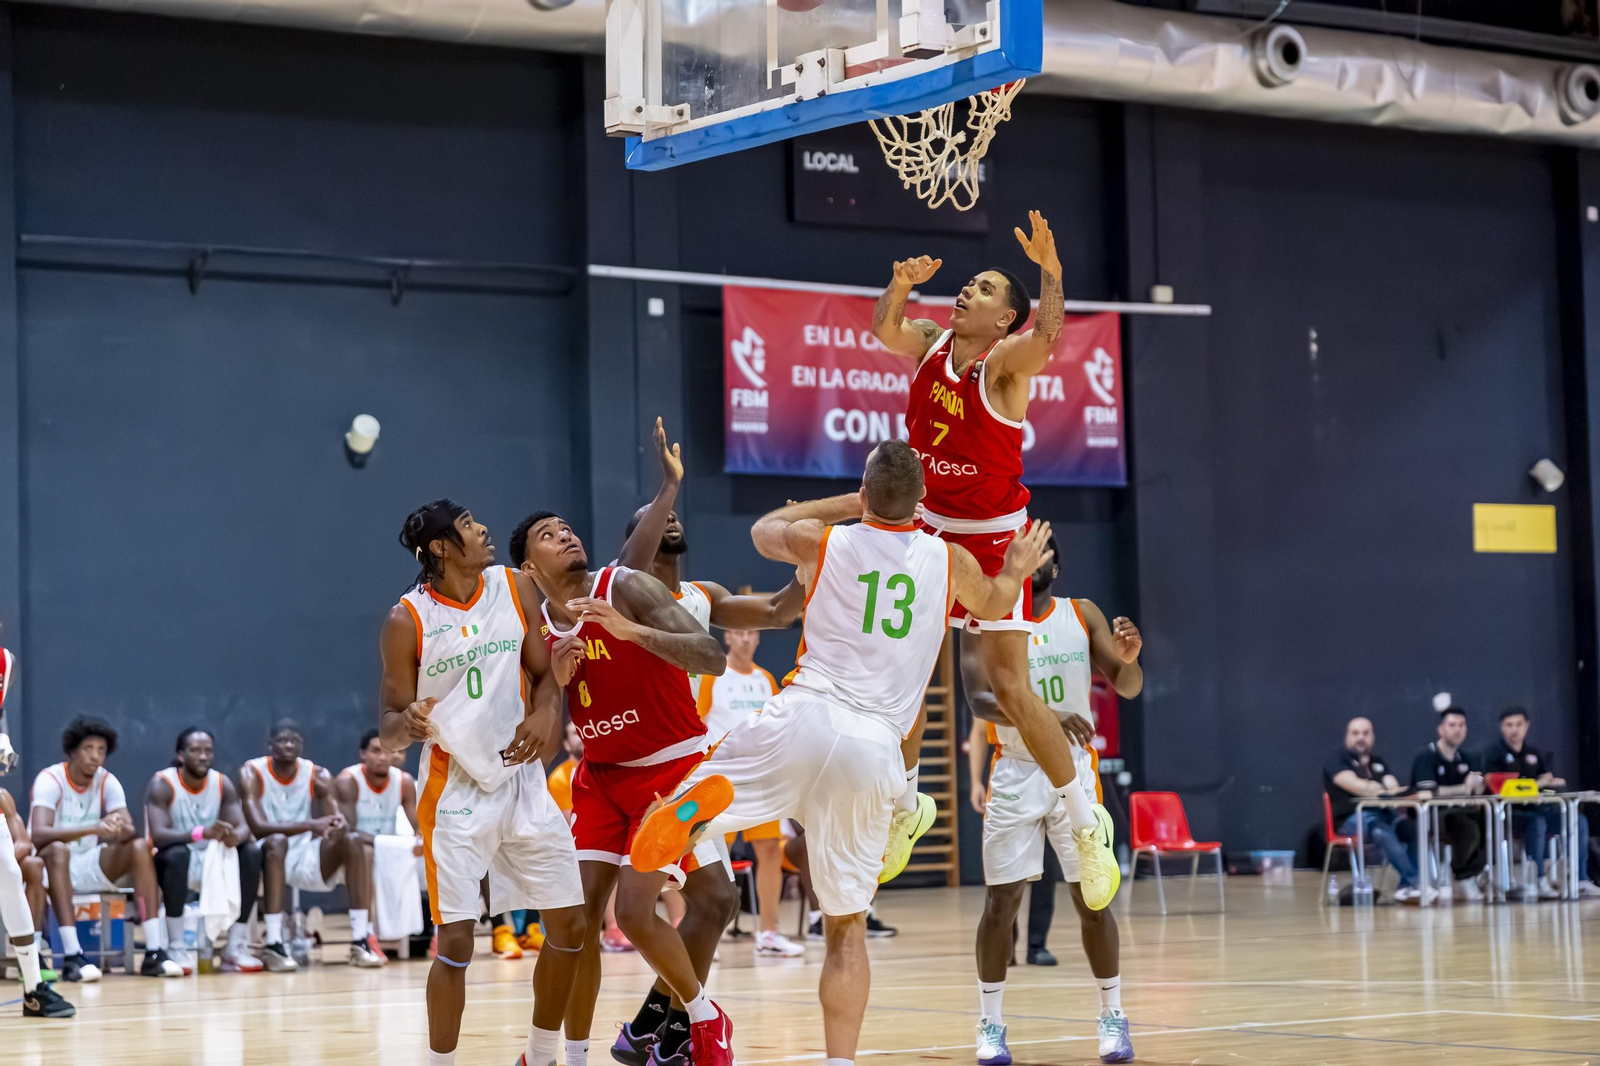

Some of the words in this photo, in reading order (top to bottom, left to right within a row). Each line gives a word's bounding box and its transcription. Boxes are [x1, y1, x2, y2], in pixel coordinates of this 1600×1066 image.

[803, 151, 859, 173] LOCAL
[803, 324, 829, 346] EN
[834, 327, 856, 348] LA
[792, 365, 816, 387] EN
[819, 367, 845, 389] LA
[847, 369, 910, 394] GRADA
[731, 388, 769, 408] FBM
[929, 381, 964, 420] PAÑA
[824, 407, 890, 443] CON
[1084, 406, 1118, 424] FBM
[930, 420, 949, 446] 7
[857, 570, 916, 639] 13
[426, 654, 466, 677] CÔTE
[467, 640, 517, 662] D'IVOIRE
[1037, 651, 1084, 667] D'IVOIRE
[466, 666, 483, 699] 0
[578, 680, 592, 708] 8
[1037, 675, 1064, 705] 10
[575, 709, 640, 740] ndesa
